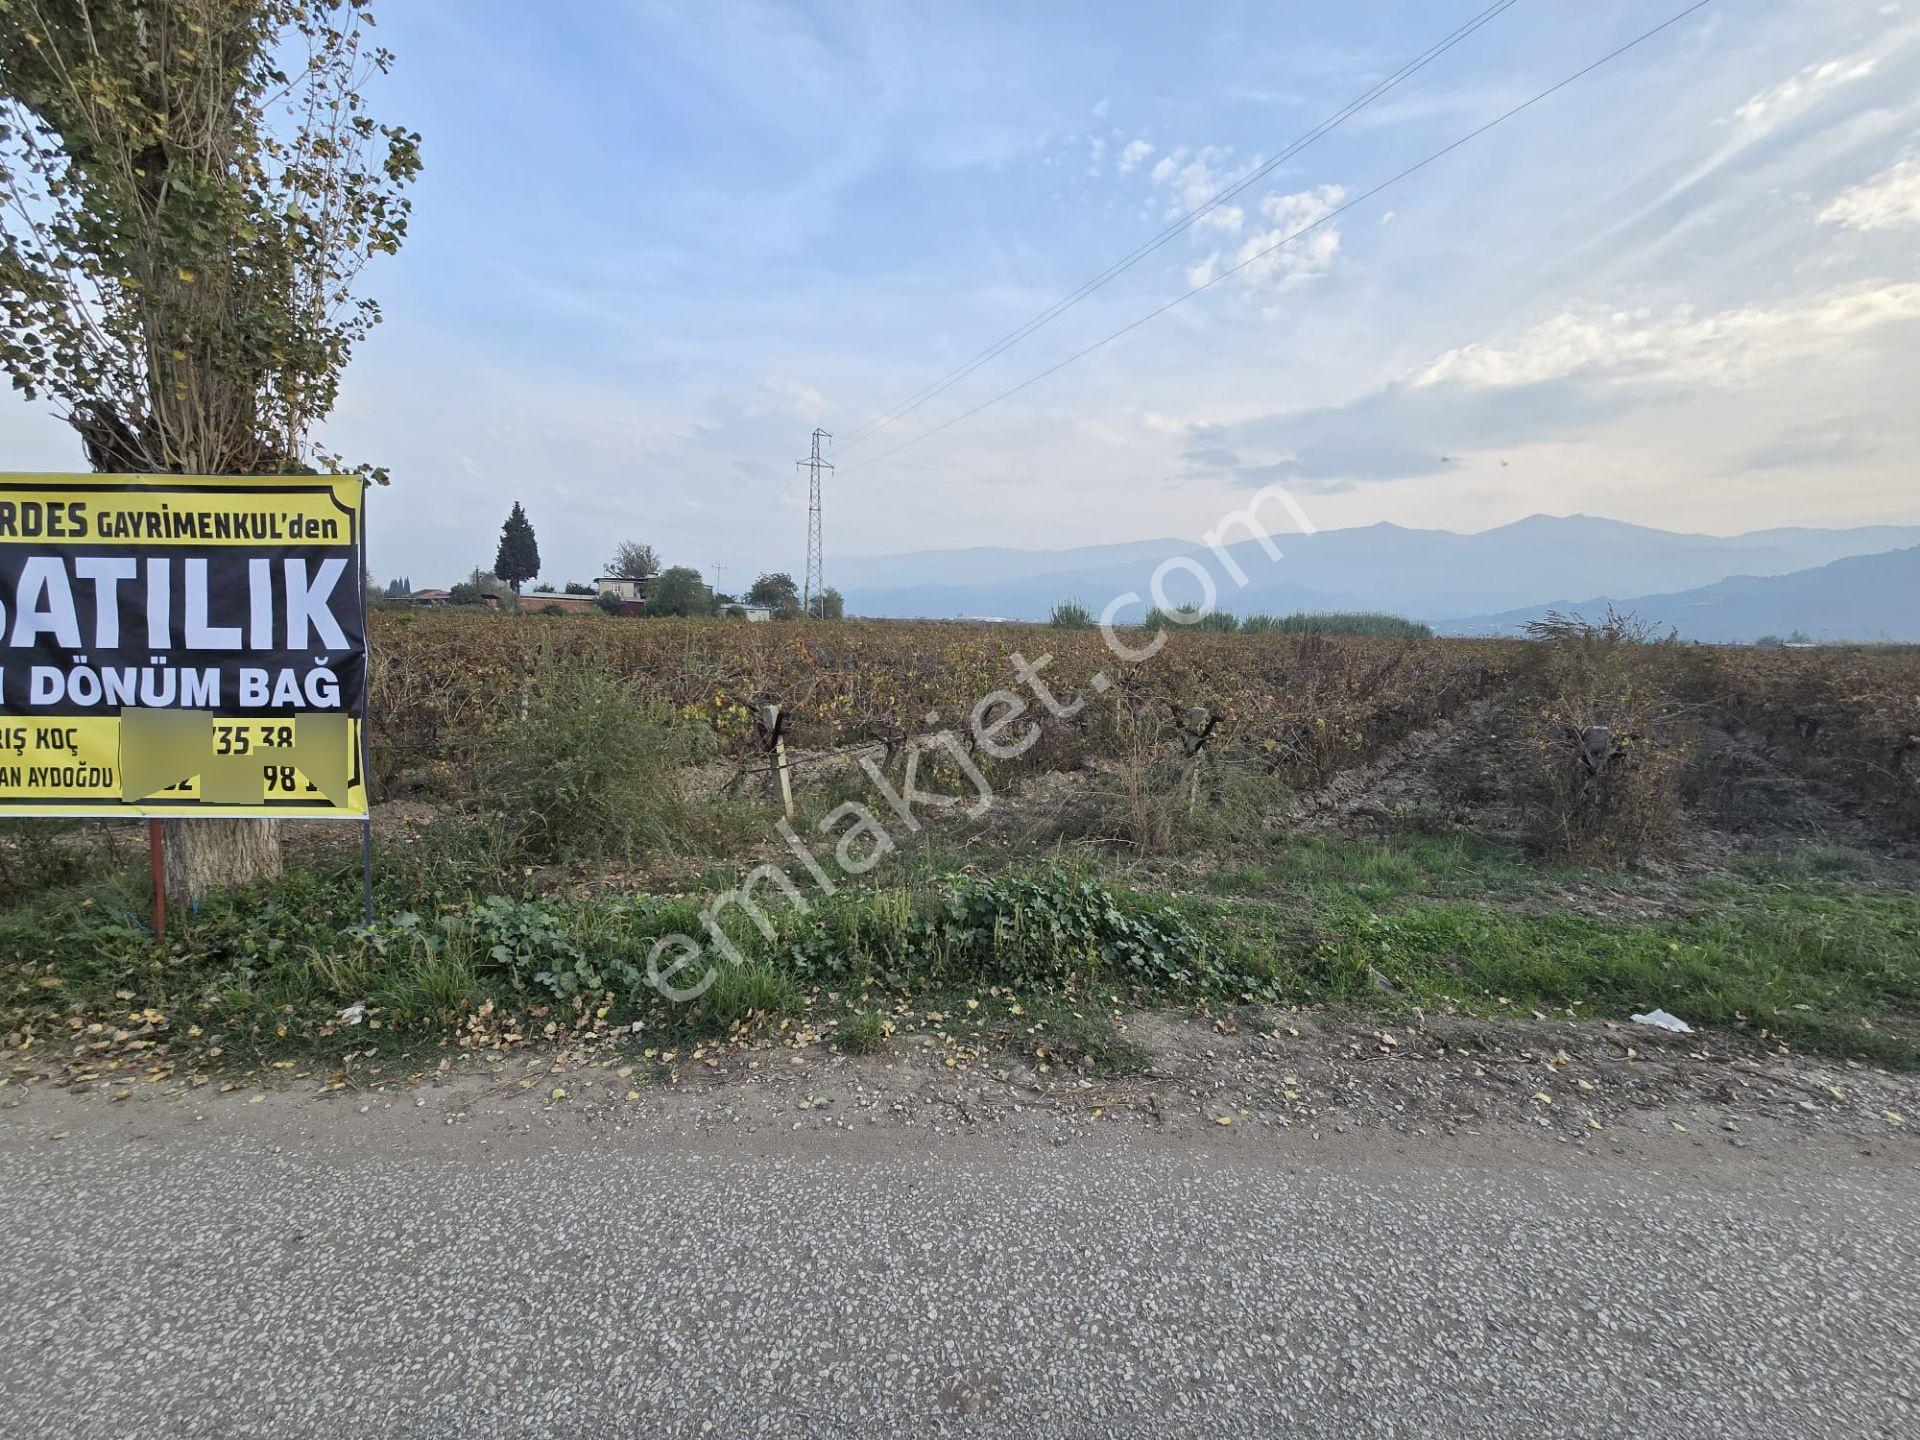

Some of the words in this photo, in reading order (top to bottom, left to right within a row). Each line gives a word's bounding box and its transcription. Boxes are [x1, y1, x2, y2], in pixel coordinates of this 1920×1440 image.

[97, 503, 338, 539] GAYRİMENKUL'den
[0, 556, 350, 650] ATILIK
[30, 655, 221, 707] DÖNÜM
[239, 656, 341, 708] BAĞ
[35, 727, 78, 757] KOÇ
[213, 726, 250, 755] 35
[27, 760, 113, 788] AYDOĞDU
